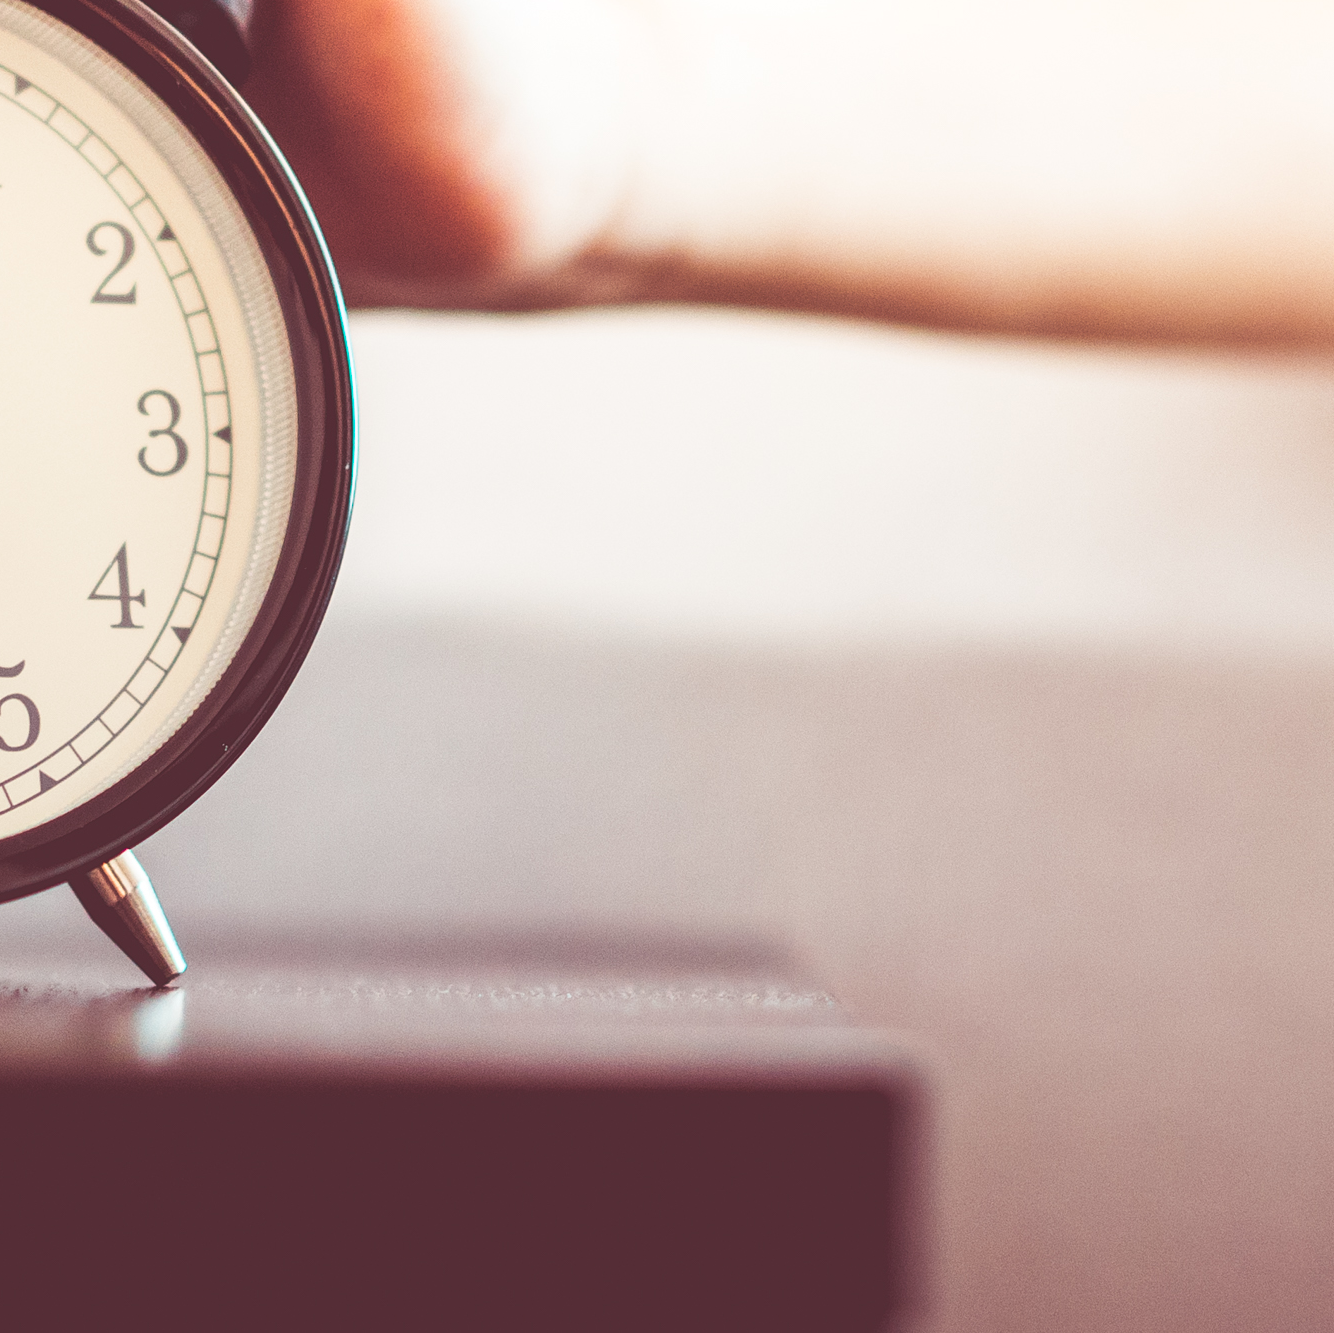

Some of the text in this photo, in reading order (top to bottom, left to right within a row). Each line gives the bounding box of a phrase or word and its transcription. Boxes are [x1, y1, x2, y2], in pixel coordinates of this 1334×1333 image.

[86, 221, 138, 305] 2
[137, 390, 188, 476] 3
[88, 541, 147, 629] 4
